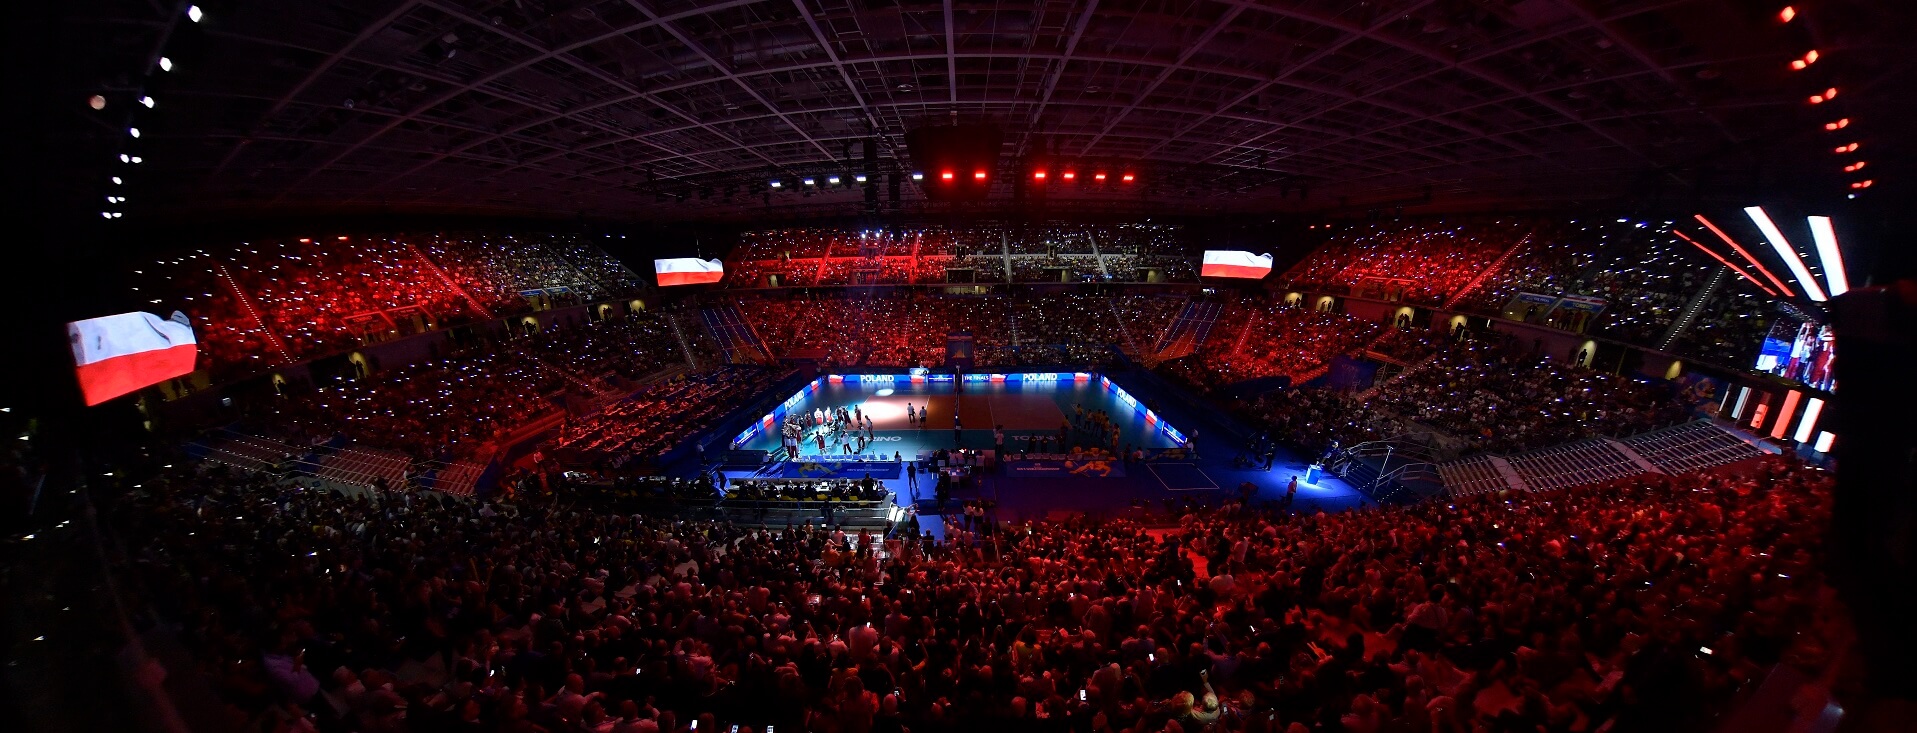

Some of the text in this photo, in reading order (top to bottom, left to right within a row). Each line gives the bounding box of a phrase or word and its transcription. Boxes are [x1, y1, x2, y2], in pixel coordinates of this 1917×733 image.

[860, 374, 894, 382] POLAND
[1023, 373, 1058, 381] POLAND
[784, 390, 805, 410] POLAND
[1117, 387, 1137, 408] POLAND
